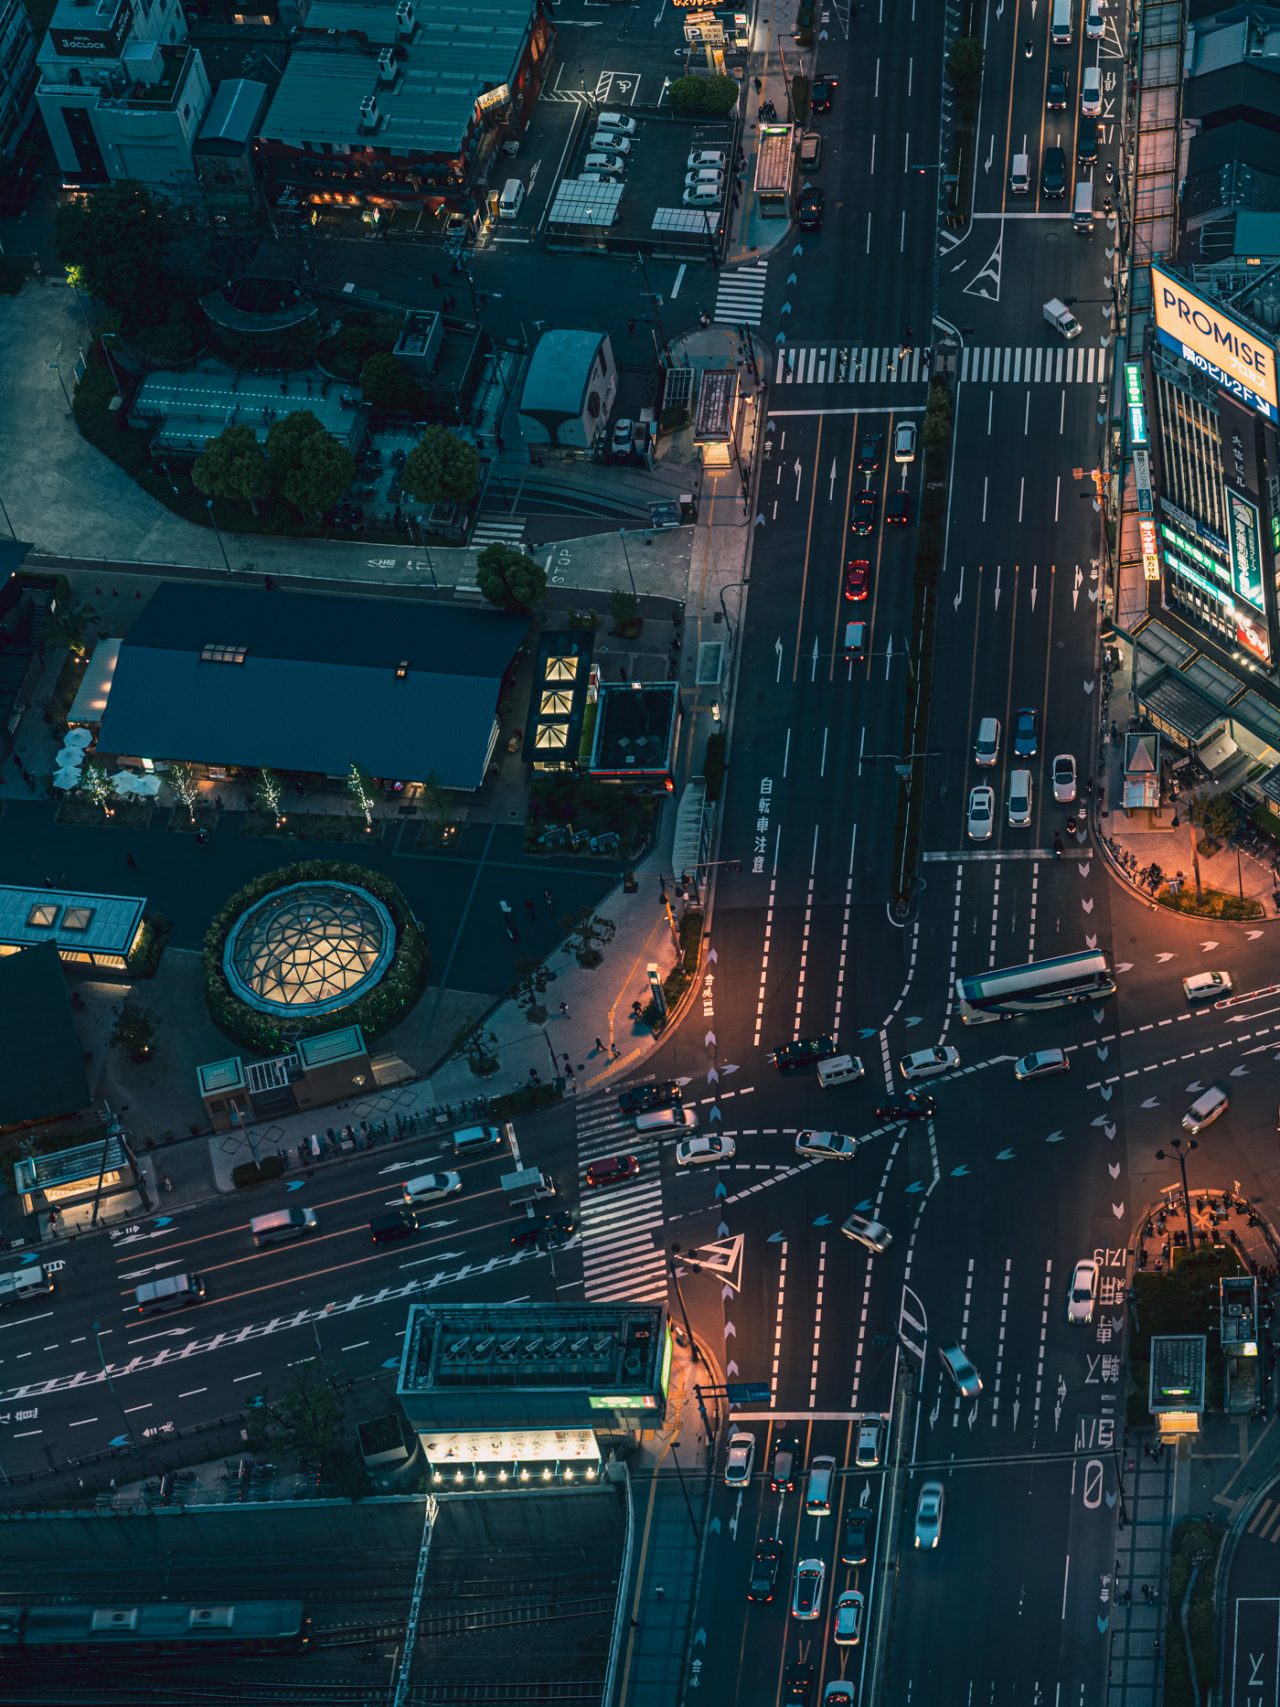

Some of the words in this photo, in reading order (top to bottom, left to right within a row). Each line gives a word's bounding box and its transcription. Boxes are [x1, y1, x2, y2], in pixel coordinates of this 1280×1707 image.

[687, 28, 701, 39] P
[1163, 287, 1266, 376] PROMISE
[1181, 343, 1254, 401] 隣のビル2F
[1228, 355, 1267, 391] プロミス
[551, 548, 573, 584] STOP
[751, 776, 773, 874] 自転車注意
